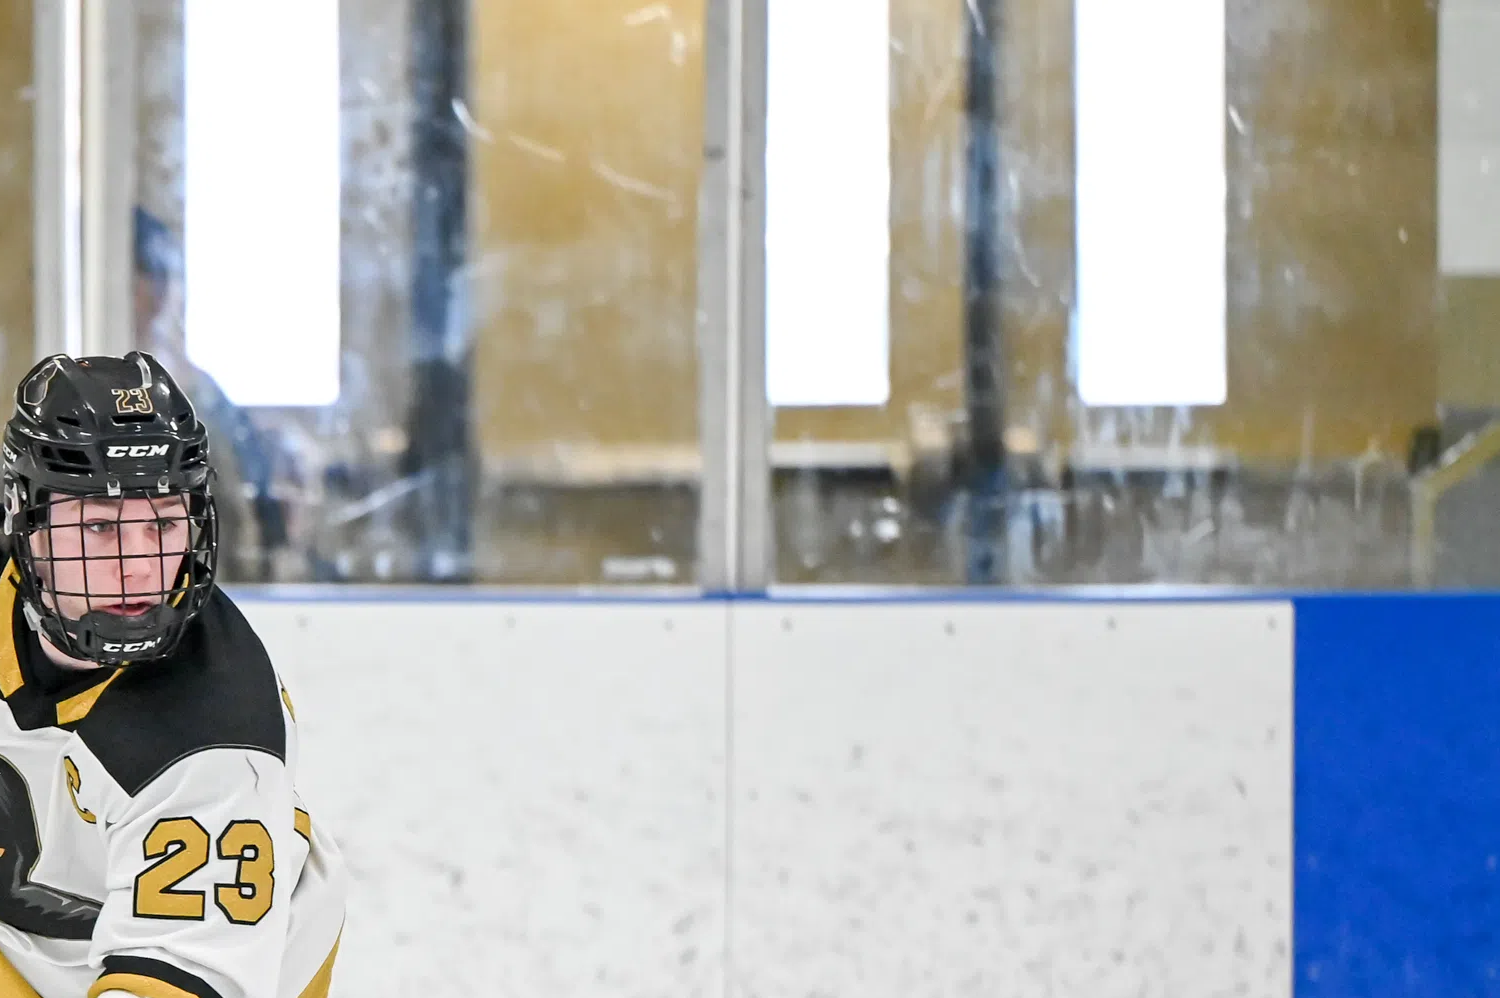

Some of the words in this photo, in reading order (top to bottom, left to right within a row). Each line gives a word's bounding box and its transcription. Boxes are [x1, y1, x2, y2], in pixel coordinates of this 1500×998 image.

[111, 388, 154, 414] 23
[106, 444, 170, 458] CCM
[132, 815, 275, 926] 23
